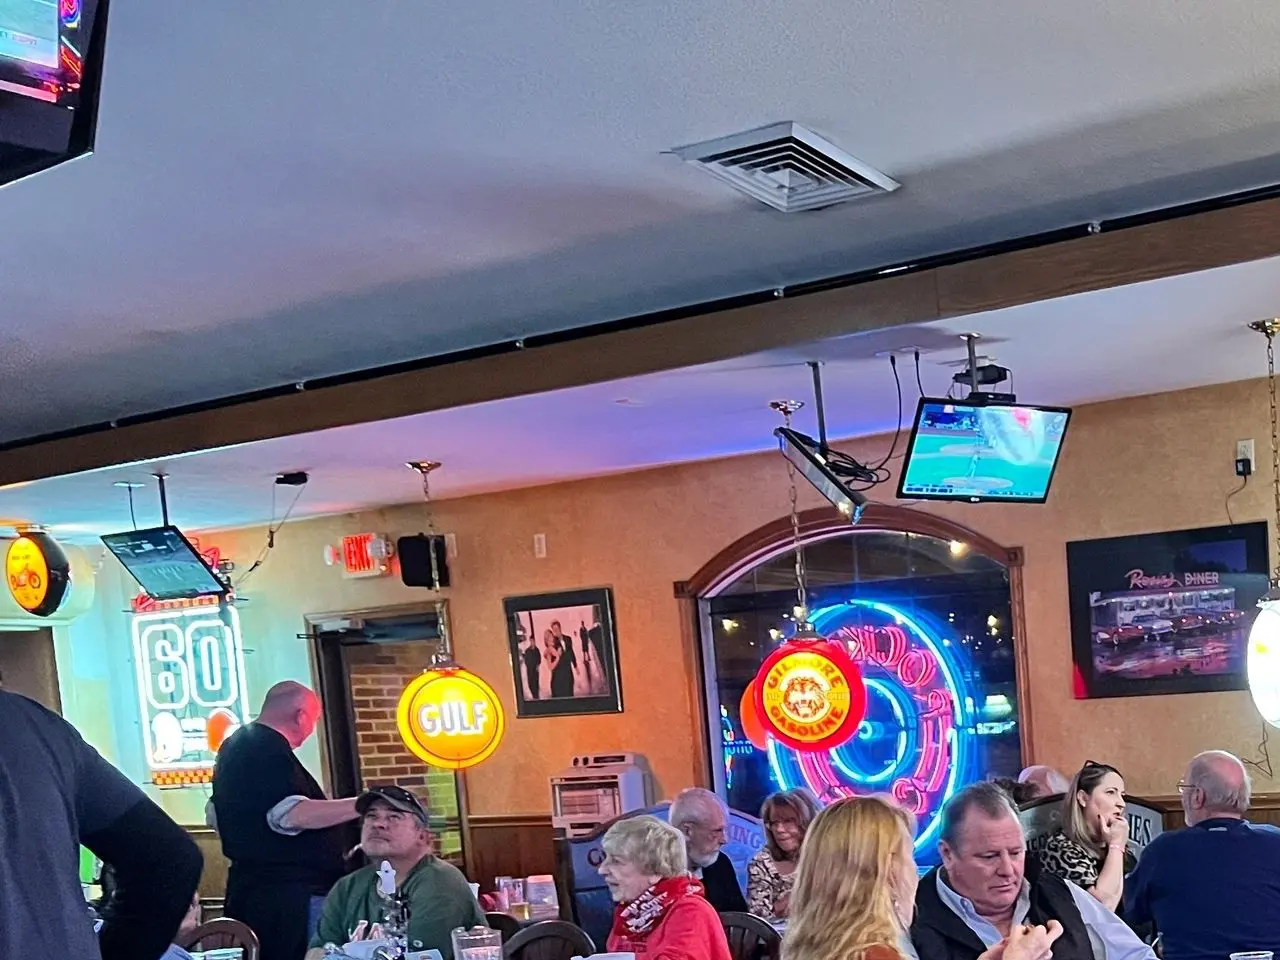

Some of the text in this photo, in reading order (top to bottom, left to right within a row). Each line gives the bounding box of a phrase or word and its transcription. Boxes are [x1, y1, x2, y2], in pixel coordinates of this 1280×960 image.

[1184, 571, 1219, 586] DINER
[418, 700, 488, 737] GULF
[770, 705, 844, 737] GASOLINE
